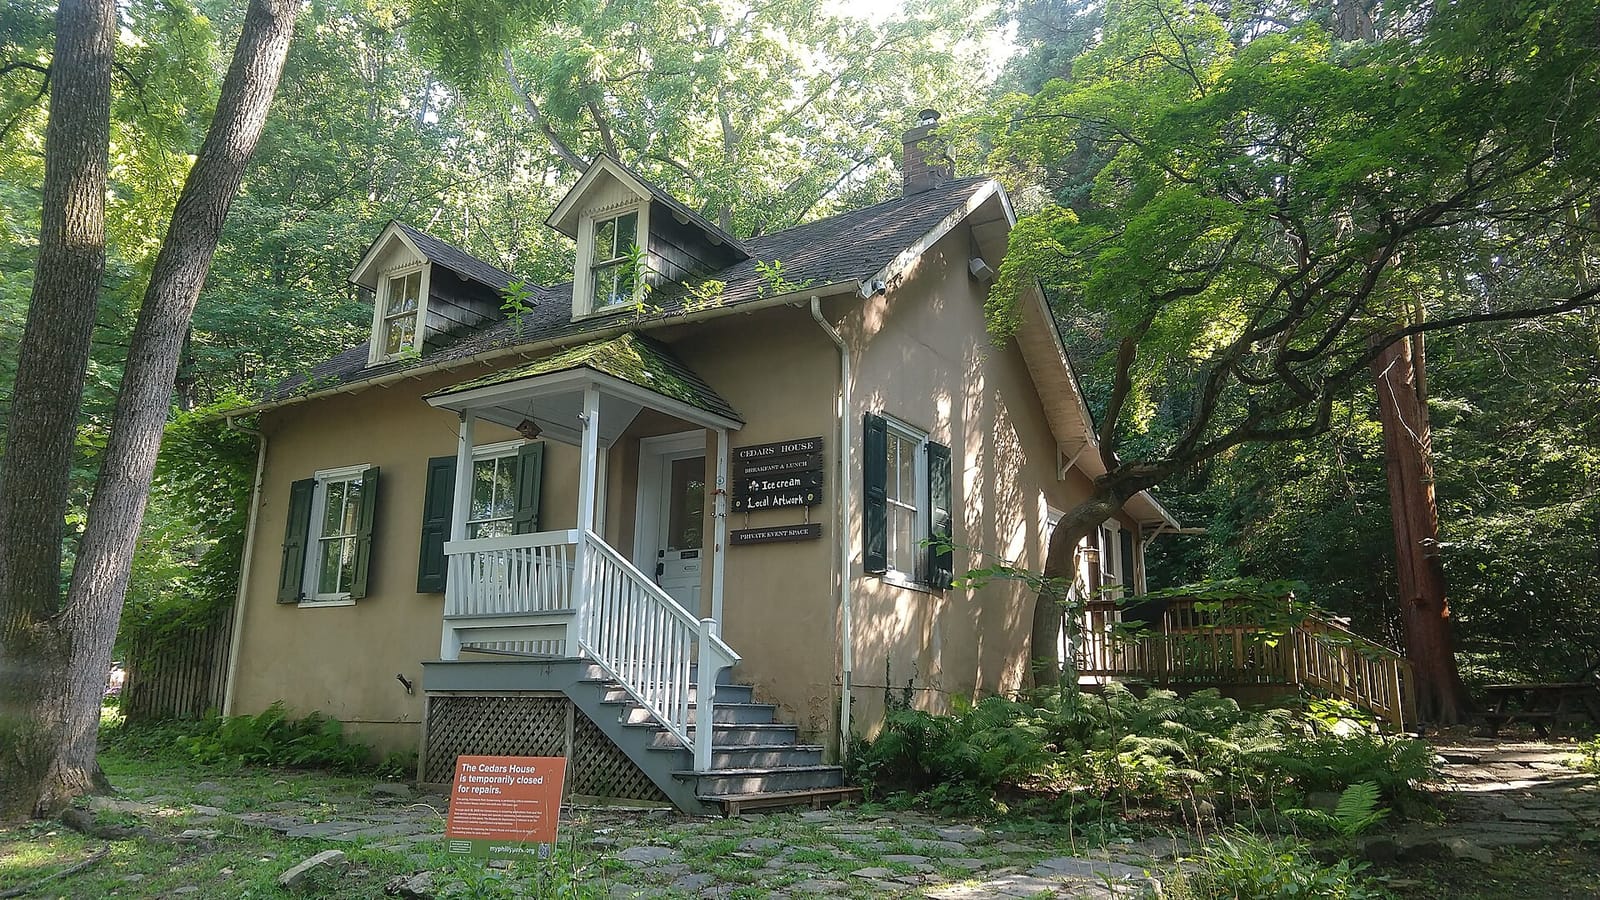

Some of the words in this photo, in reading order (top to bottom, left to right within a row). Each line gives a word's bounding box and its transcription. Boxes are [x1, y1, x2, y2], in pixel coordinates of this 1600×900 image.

[740, 448, 774, 458] CEDARS
[781, 442, 814, 452] HOUSE
[744, 464, 779, 474] BREAKFAST
[786, 460, 807, 469] LUNCH
[761, 481, 776, 490] Ice
[776, 478, 801, 488] cream
[747, 495, 770, 509] Local
[772, 494, 804, 507] Artwork
[740, 533, 767, 541] PRIVATE
[767, 530, 788, 538] EVENT
[788, 528, 809, 536] SPACE
[462, 764, 476, 772] The
[478, 763, 507, 773] Cedars
[509, 764, 536, 774] House
[460, 773, 467, 783] is
[468, 774, 515, 786] temporarily
[516, 776, 544, 784] closed
[458, 784, 470, 793] for
[472, 786, 502, 795] repairs.
